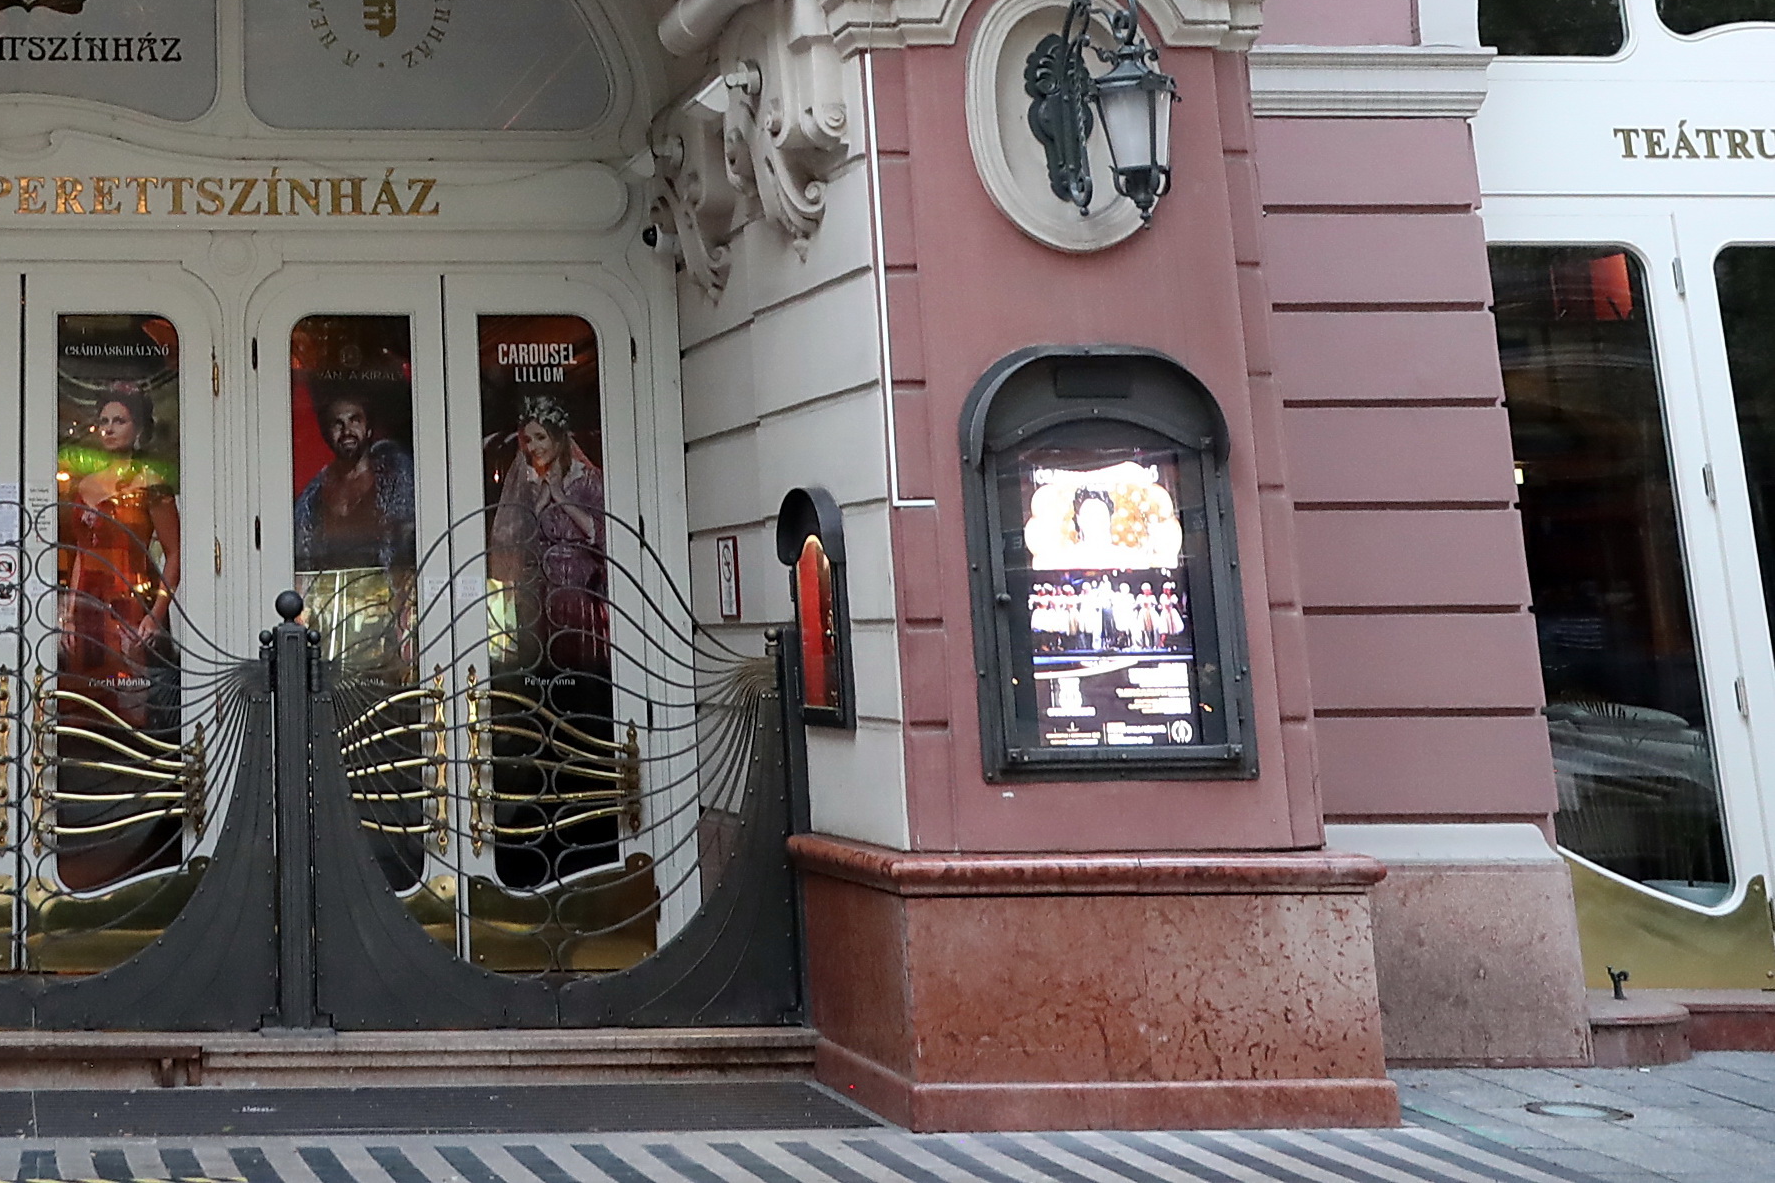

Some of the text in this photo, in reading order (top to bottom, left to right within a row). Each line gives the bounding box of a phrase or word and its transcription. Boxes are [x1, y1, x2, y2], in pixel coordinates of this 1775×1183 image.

[1613, 119, 1775, 160] TEÁTRU
[497, 342, 578, 366] CAROUSEL
[514, 366, 565, 383] LILIOM
[117, 676, 151, 687] Mónika
